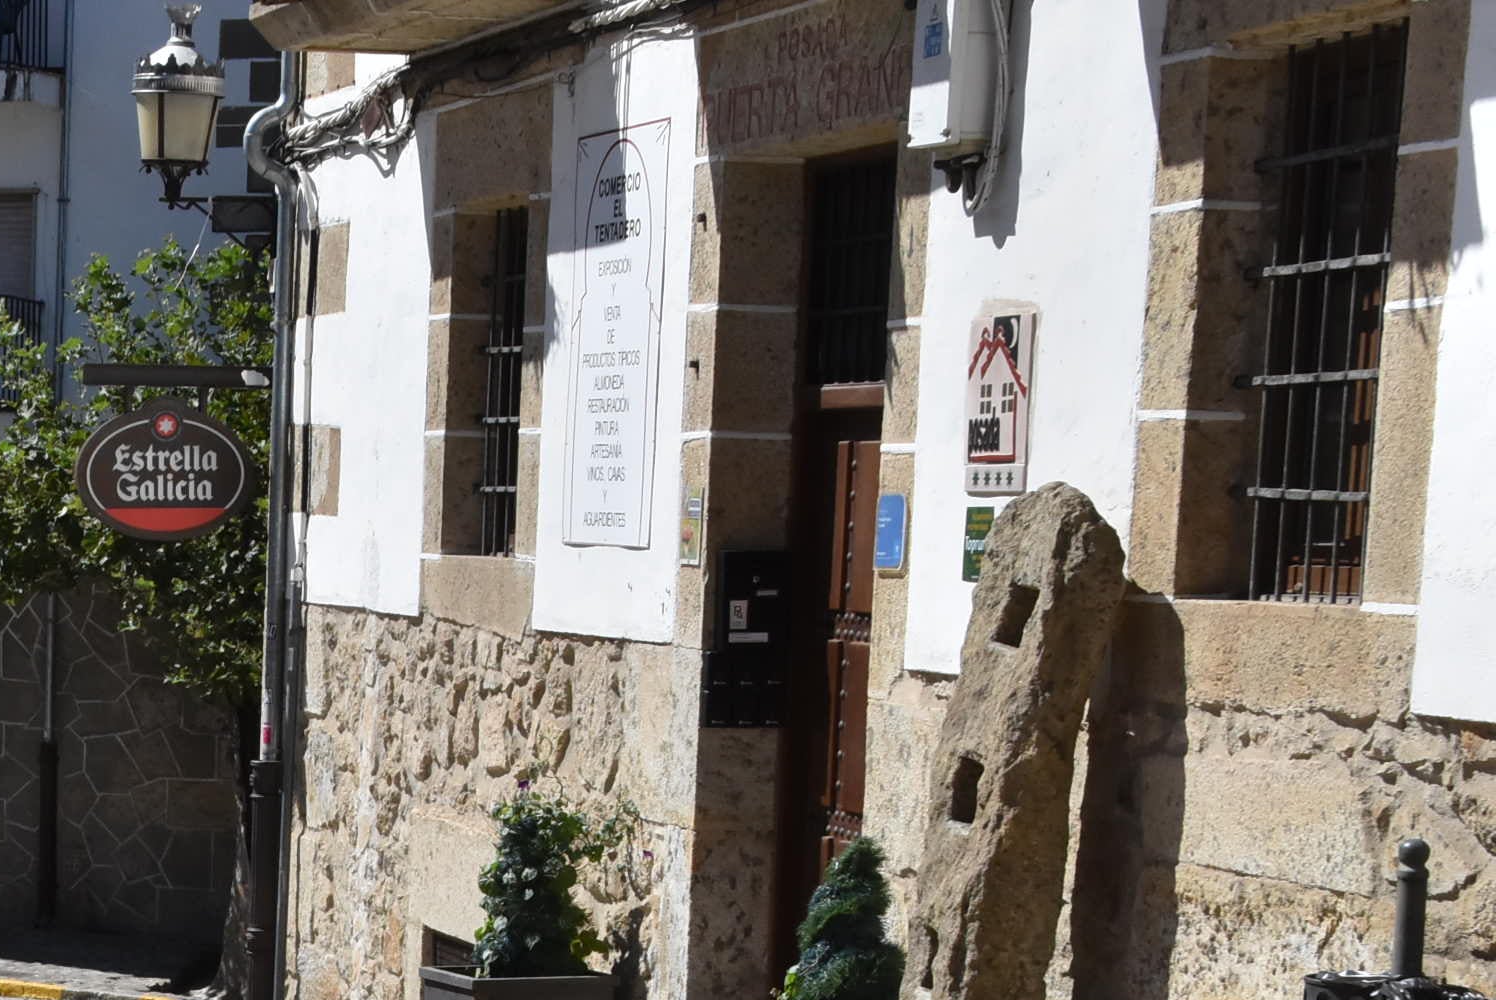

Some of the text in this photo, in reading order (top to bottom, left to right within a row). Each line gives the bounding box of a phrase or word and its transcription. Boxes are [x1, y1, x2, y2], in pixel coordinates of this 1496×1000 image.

[598, 172, 641, 198] COMERCIO
[613, 200, 623, 218] EL
[595, 219, 641, 243] TENTADERO
[598, 256, 632, 277] EXPOSICIÓN
[611, 283, 616, 297] Y
[603, 305, 621, 321] VENTA
[607, 328, 616, 345] DE
[582, 352, 615, 368] PRODUCTOS
[593, 374, 624, 391] ALMONEDA
[594, 421, 619, 436] PINTURA
[968, 406, 1000, 458] posada
[112, 444, 218, 472] Estrella
[117, 473, 213, 501] Galicia
[583, 512, 626, 528] AGUARDIENTES
